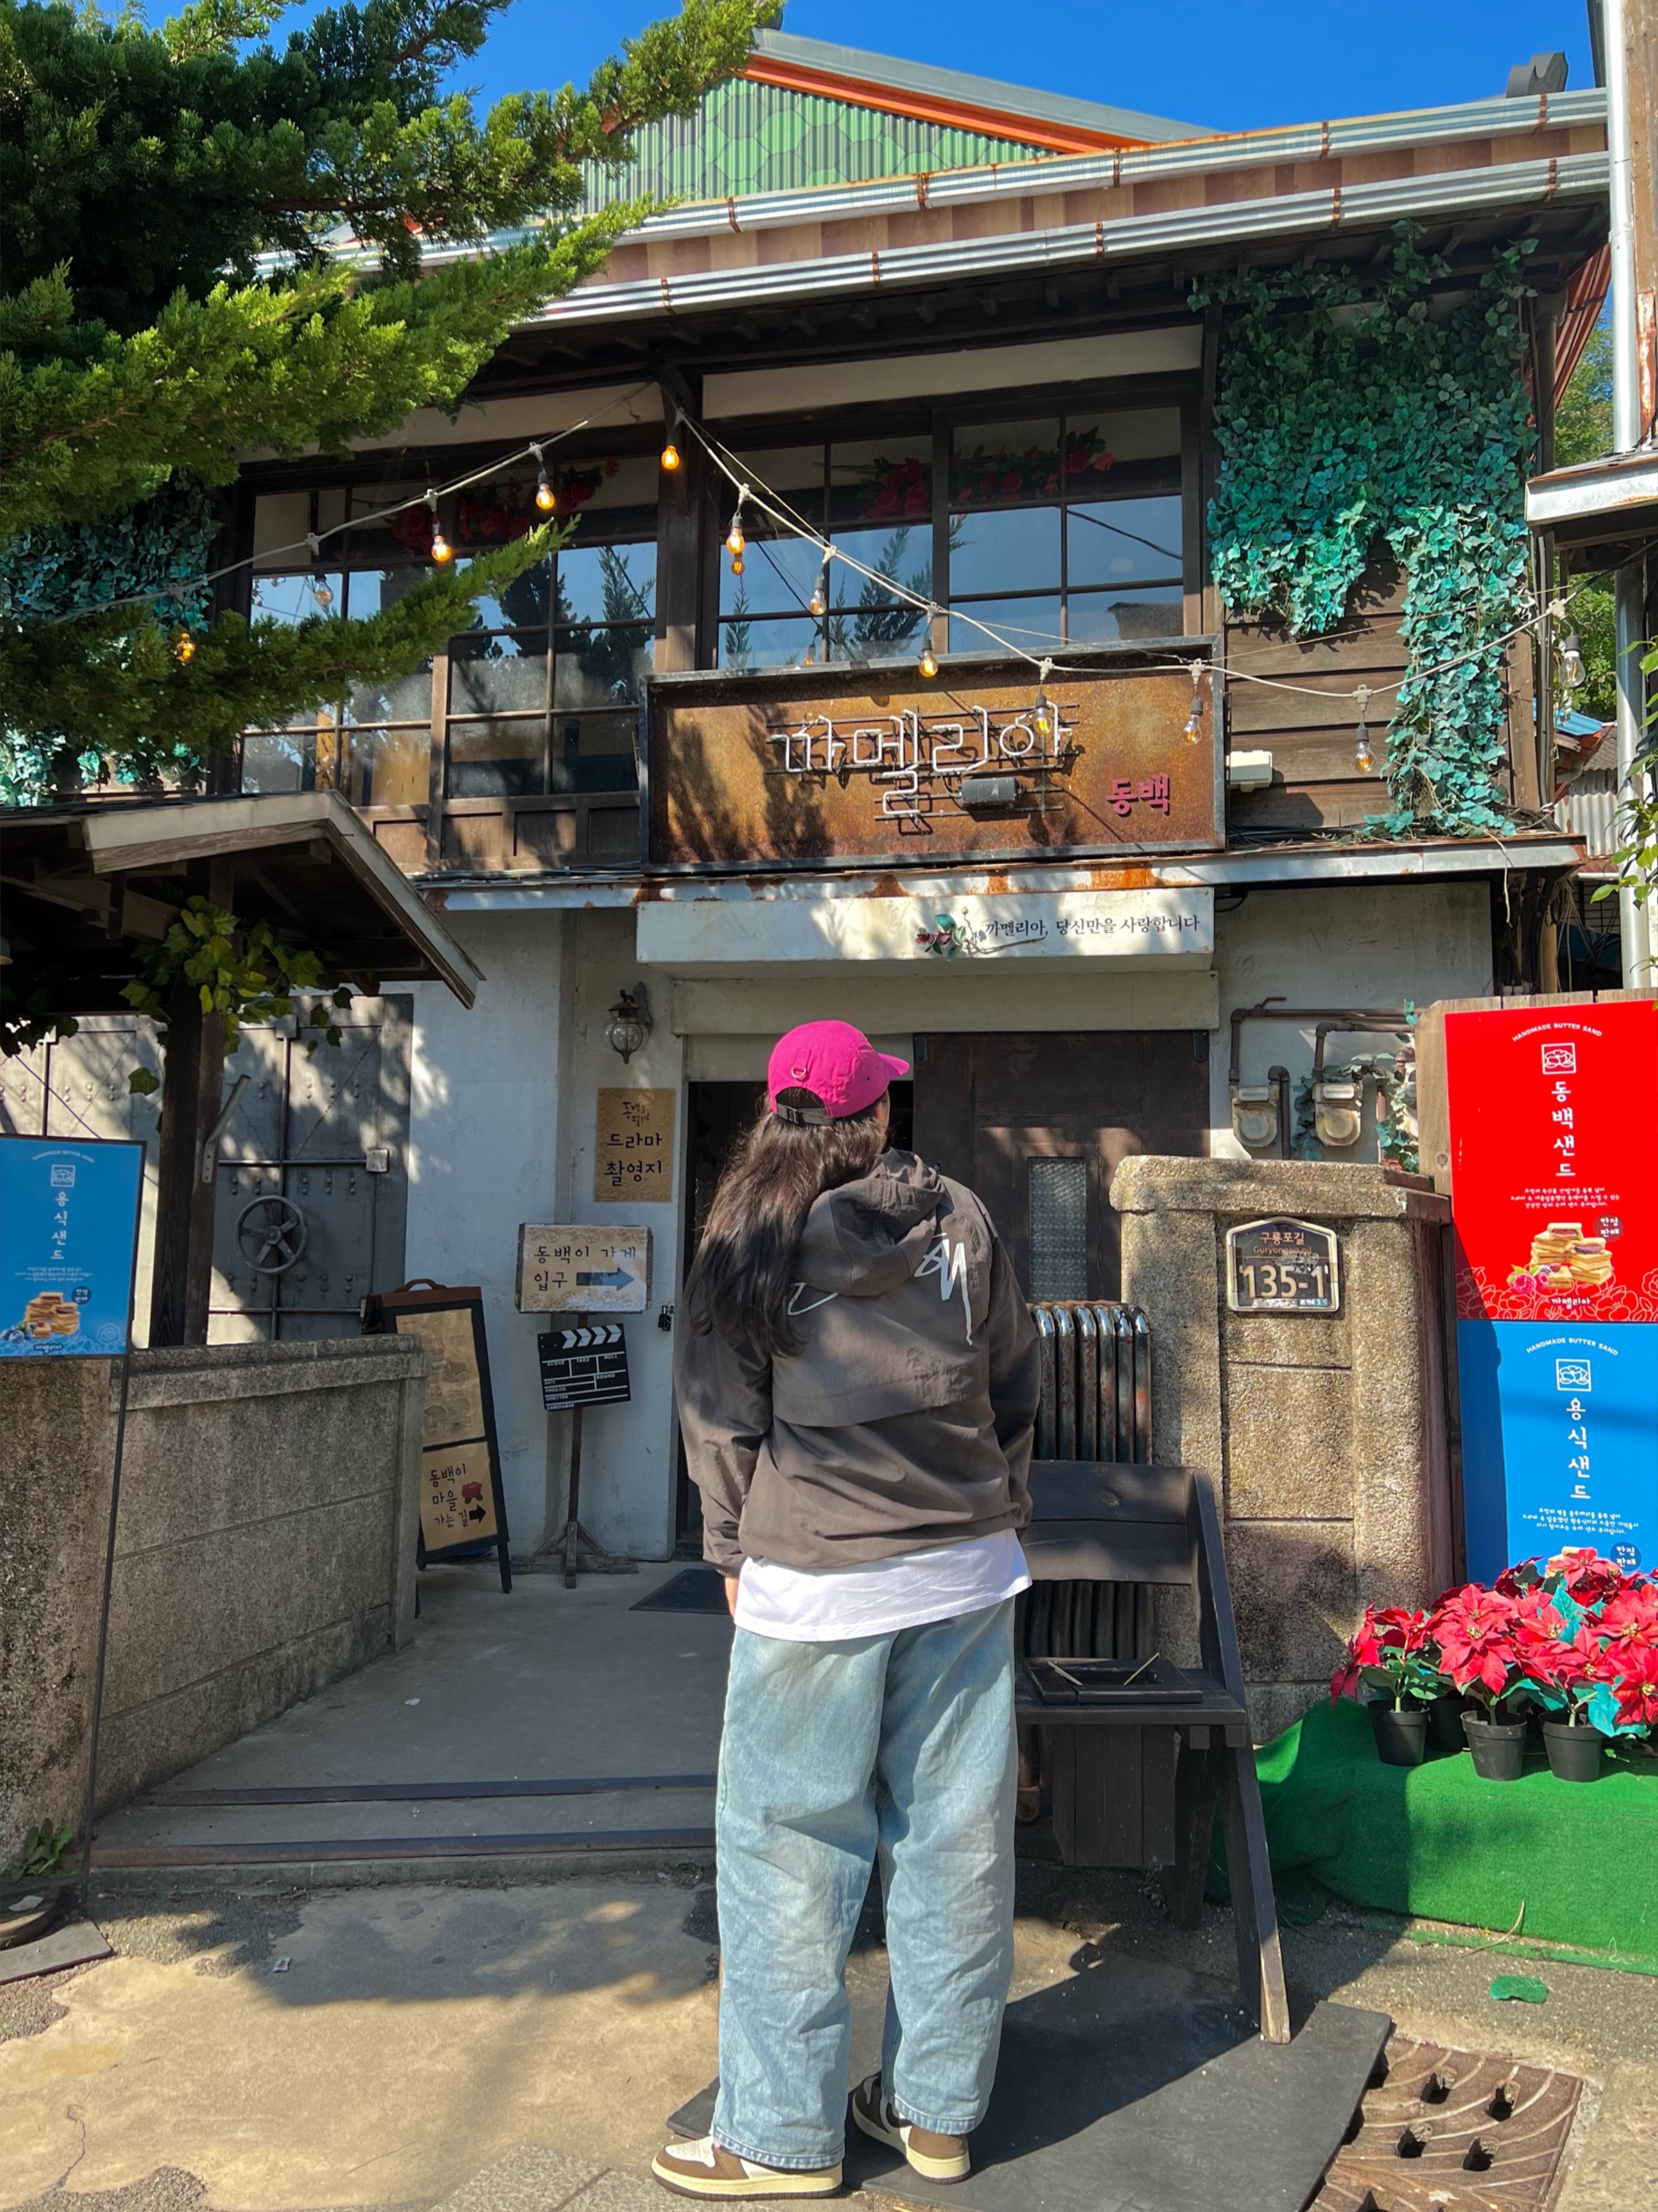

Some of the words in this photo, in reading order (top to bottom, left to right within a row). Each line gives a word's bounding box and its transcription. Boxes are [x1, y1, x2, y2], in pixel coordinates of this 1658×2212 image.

[770, 701, 1073, 815] 까멜리아
[1106, 773, 1170, 817] 동백
[985, 921, 1048, 938] 까멜리아,
[1055, 918, 1116, 935] 당신만을
[1120, 915, 1199, 934] 사랑합니다
[1512, 1023, 1551, 1042] HANDMADE
[1582, 1026, 1603, 1037] SAND
[1551, 1081, 1576, 1176] 동백샌드
[606, 1132, 663, 1148] 드라마
[605, 1160, 662, 1187] 촬영지
[1601, 1217, 1618, 1227] 한정
[1260, 1232, 1304, 1245] 구룡포길
[1601, 1228, 1620, 1237] 판매
[534, 1245, 590, 1264] 동백이
[601, 1246, 636, 1259] 가게
[1253, 1246, 1312, 1255] Guryongpo-gil
[534, 1271, 568, 1292] 입구
[1243, 1264, 1324, 1299] 135-1
[1551, 1297, 1590, 1309] 까멜리아
[1526, 1338, 1566, 1353] HANDMADE
[1568, 1338, 1596, 1347] BUTTER
[1598, 1343, 1618, 1355] SAND
[1566, 1397, 1590, 1499] 용식샌드
[429, 1463, 466, 1488] 동백이
[432, 1489, 457, 1511] 마을
[435, 1512, 455, 1528] 가는
[459, 1511, 469, 1527] 길
[1617, 1546, 1635, 1556] 한정
[1617, 1558, 1636, 1567] 판매
